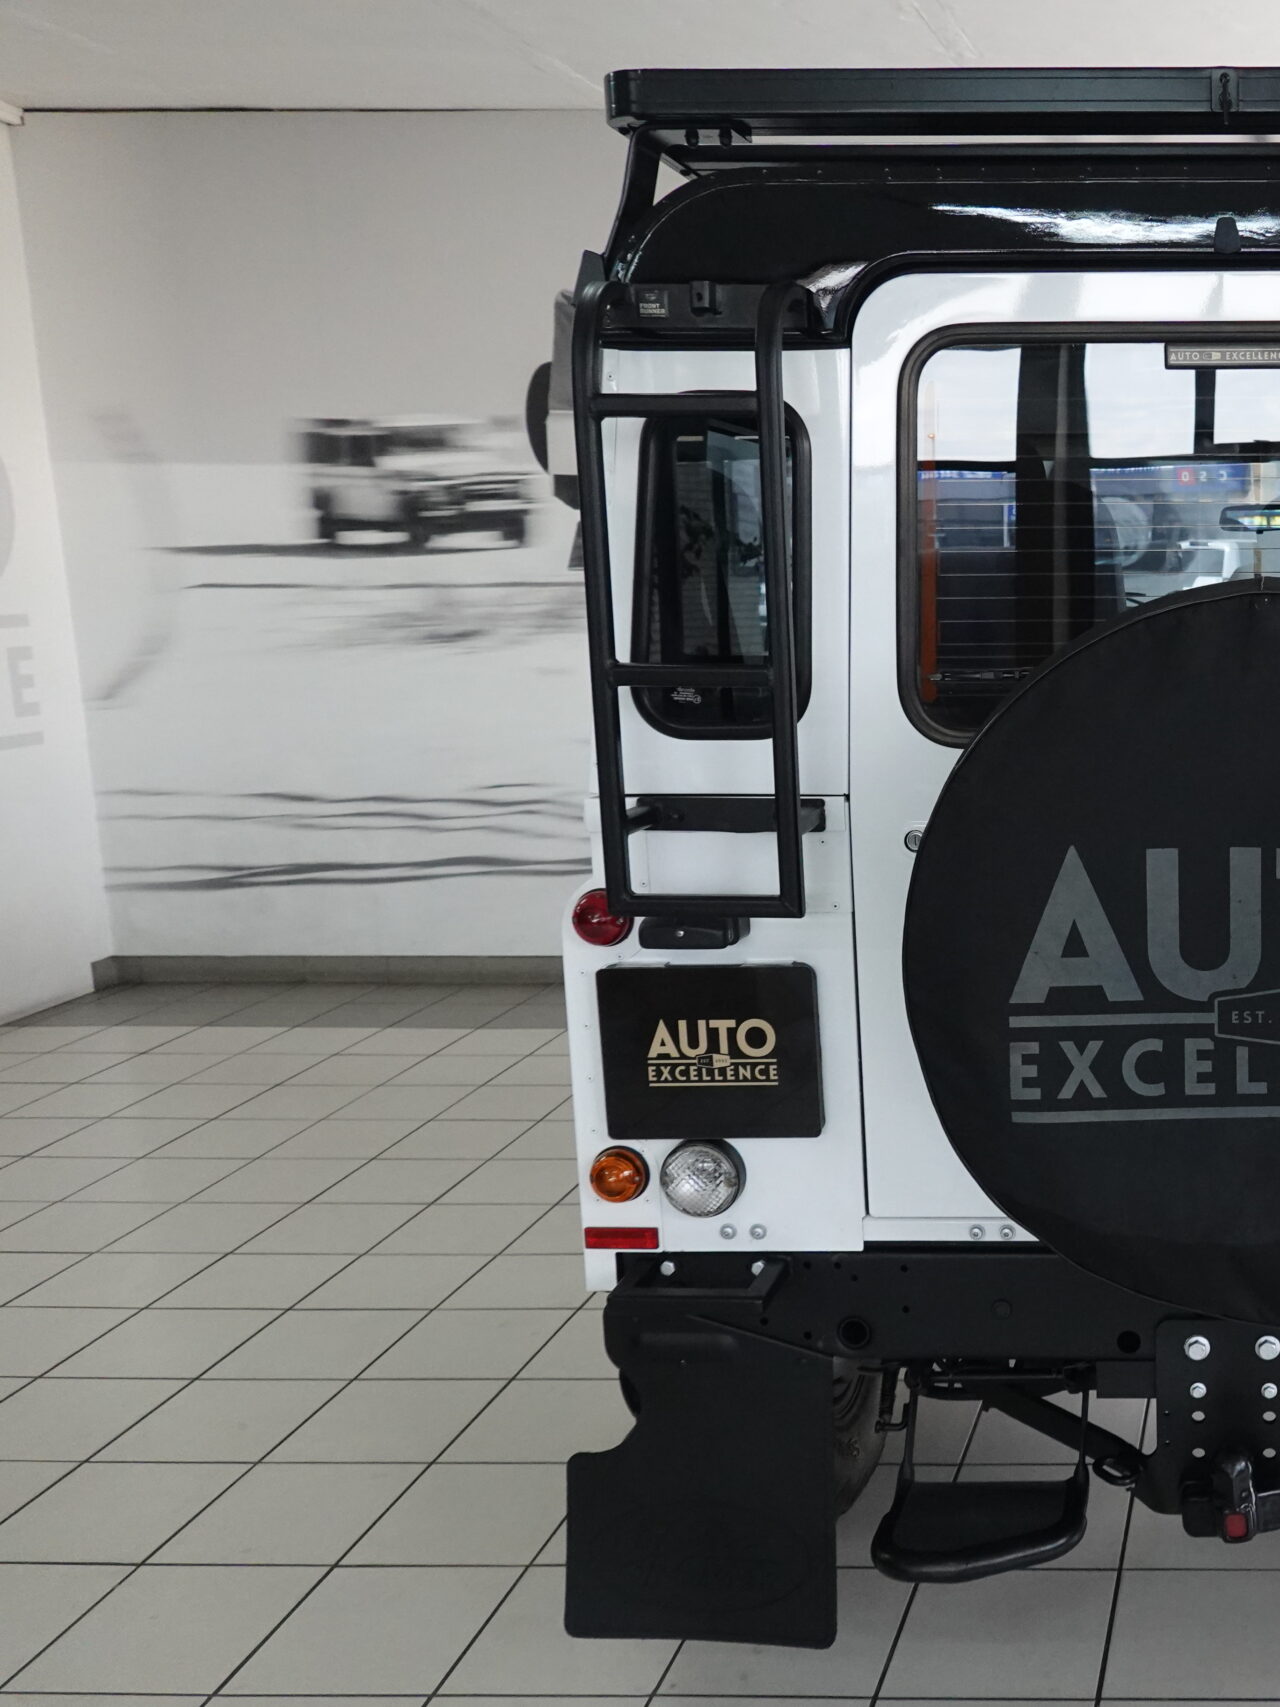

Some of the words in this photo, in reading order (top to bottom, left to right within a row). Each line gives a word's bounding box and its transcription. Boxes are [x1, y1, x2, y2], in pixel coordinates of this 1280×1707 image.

[1169, 351, 1200, 361] AUTO
[1231, 1010, 1273, 1024] EST.
[647, 1018, 776, 1058] AUTO
[648, 1065, 778, 1081] EXCELLENCE
